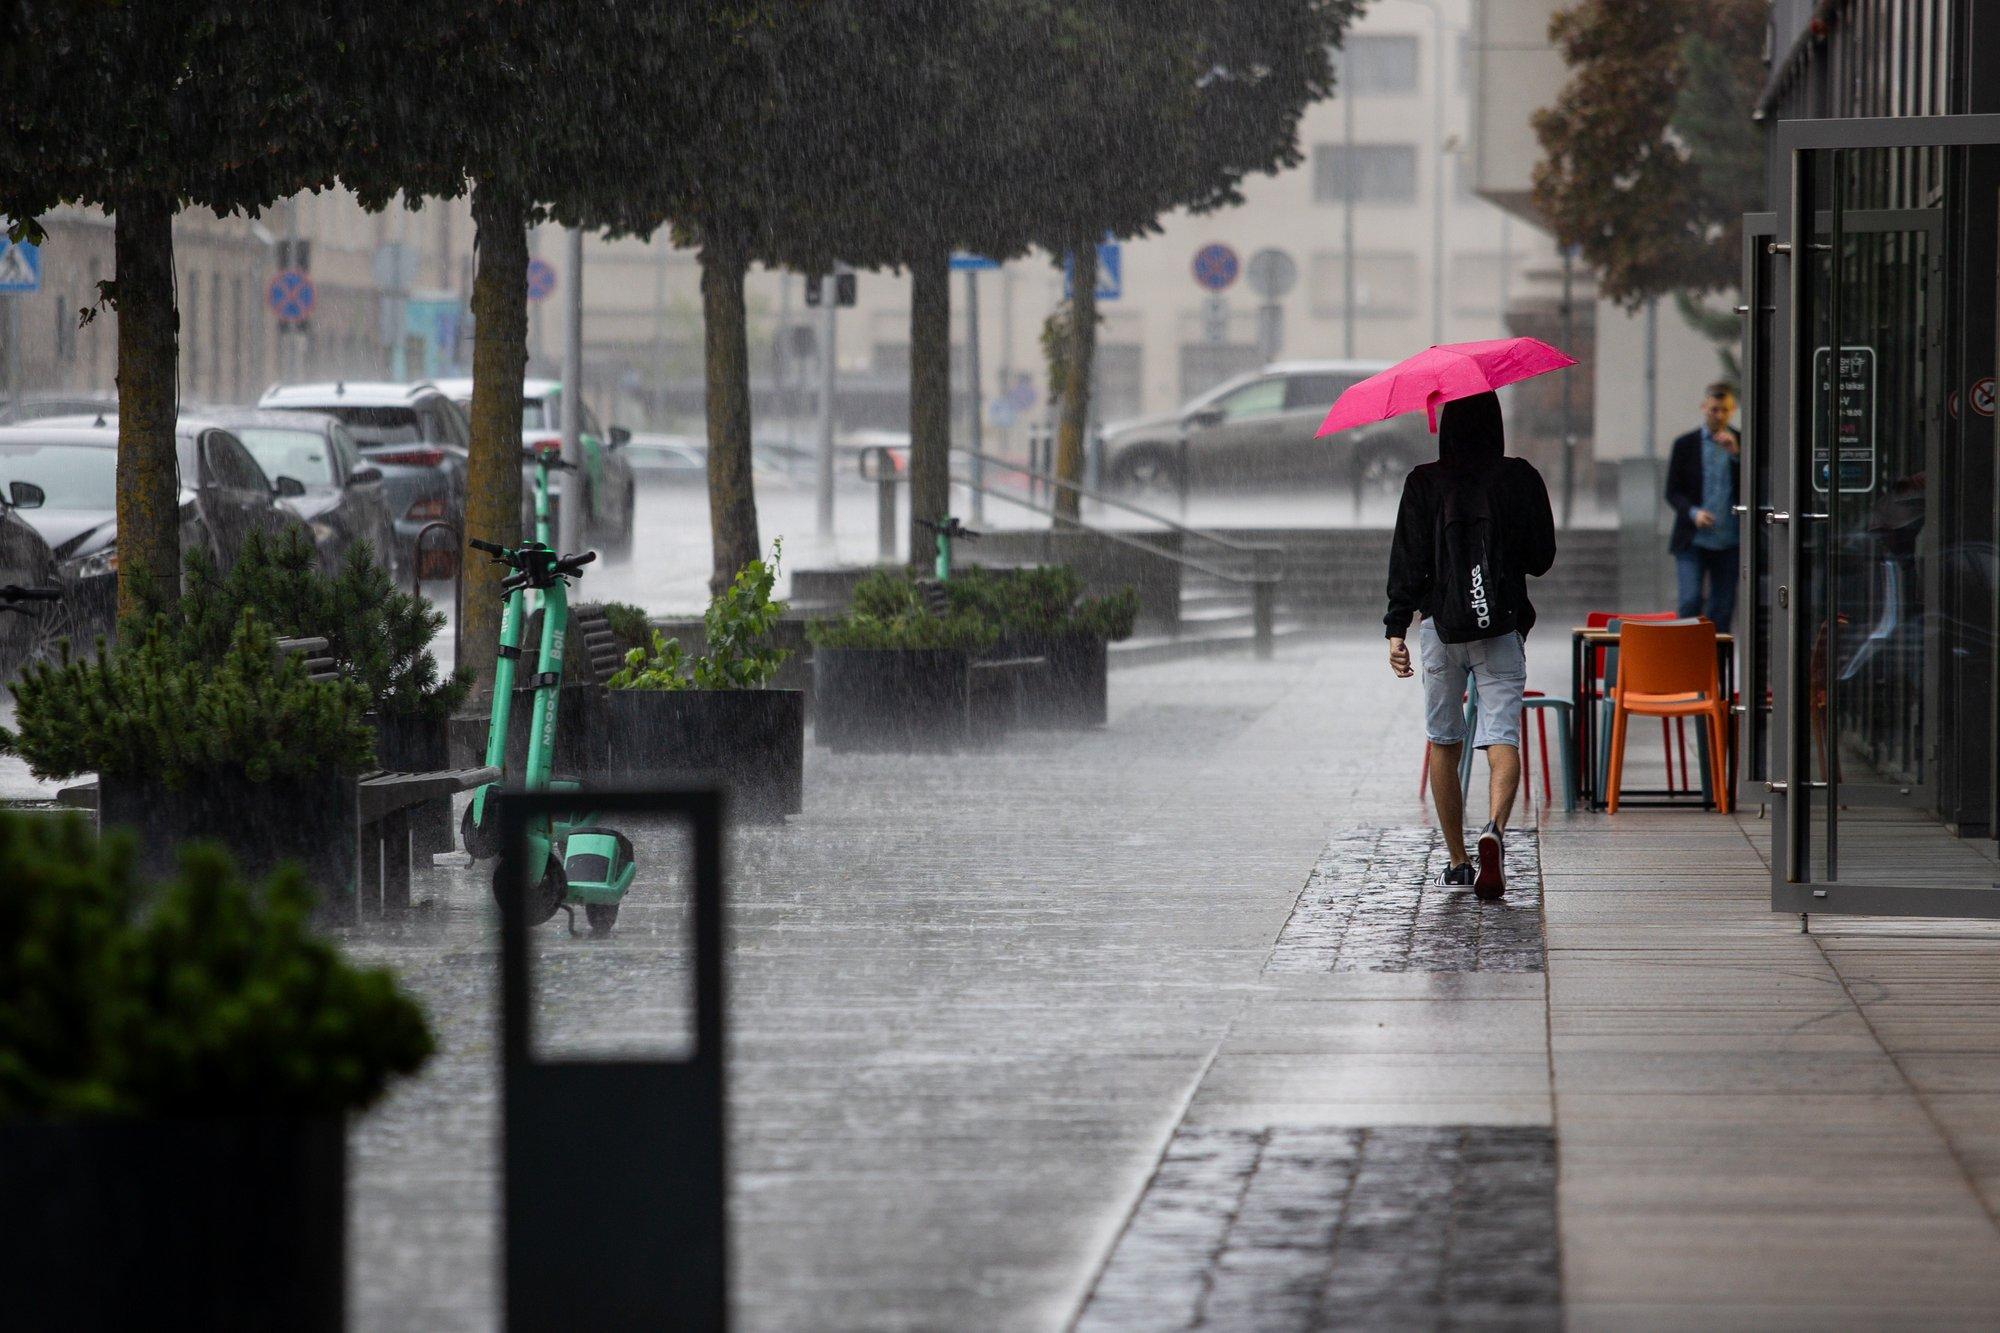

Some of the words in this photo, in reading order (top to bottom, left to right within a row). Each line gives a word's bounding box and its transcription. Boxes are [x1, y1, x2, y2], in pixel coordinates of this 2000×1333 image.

[1470, 564, 1490, 628] adidas
[550, 629, 564, 660] Bolt
[543, 688, 557, 746] V0062
